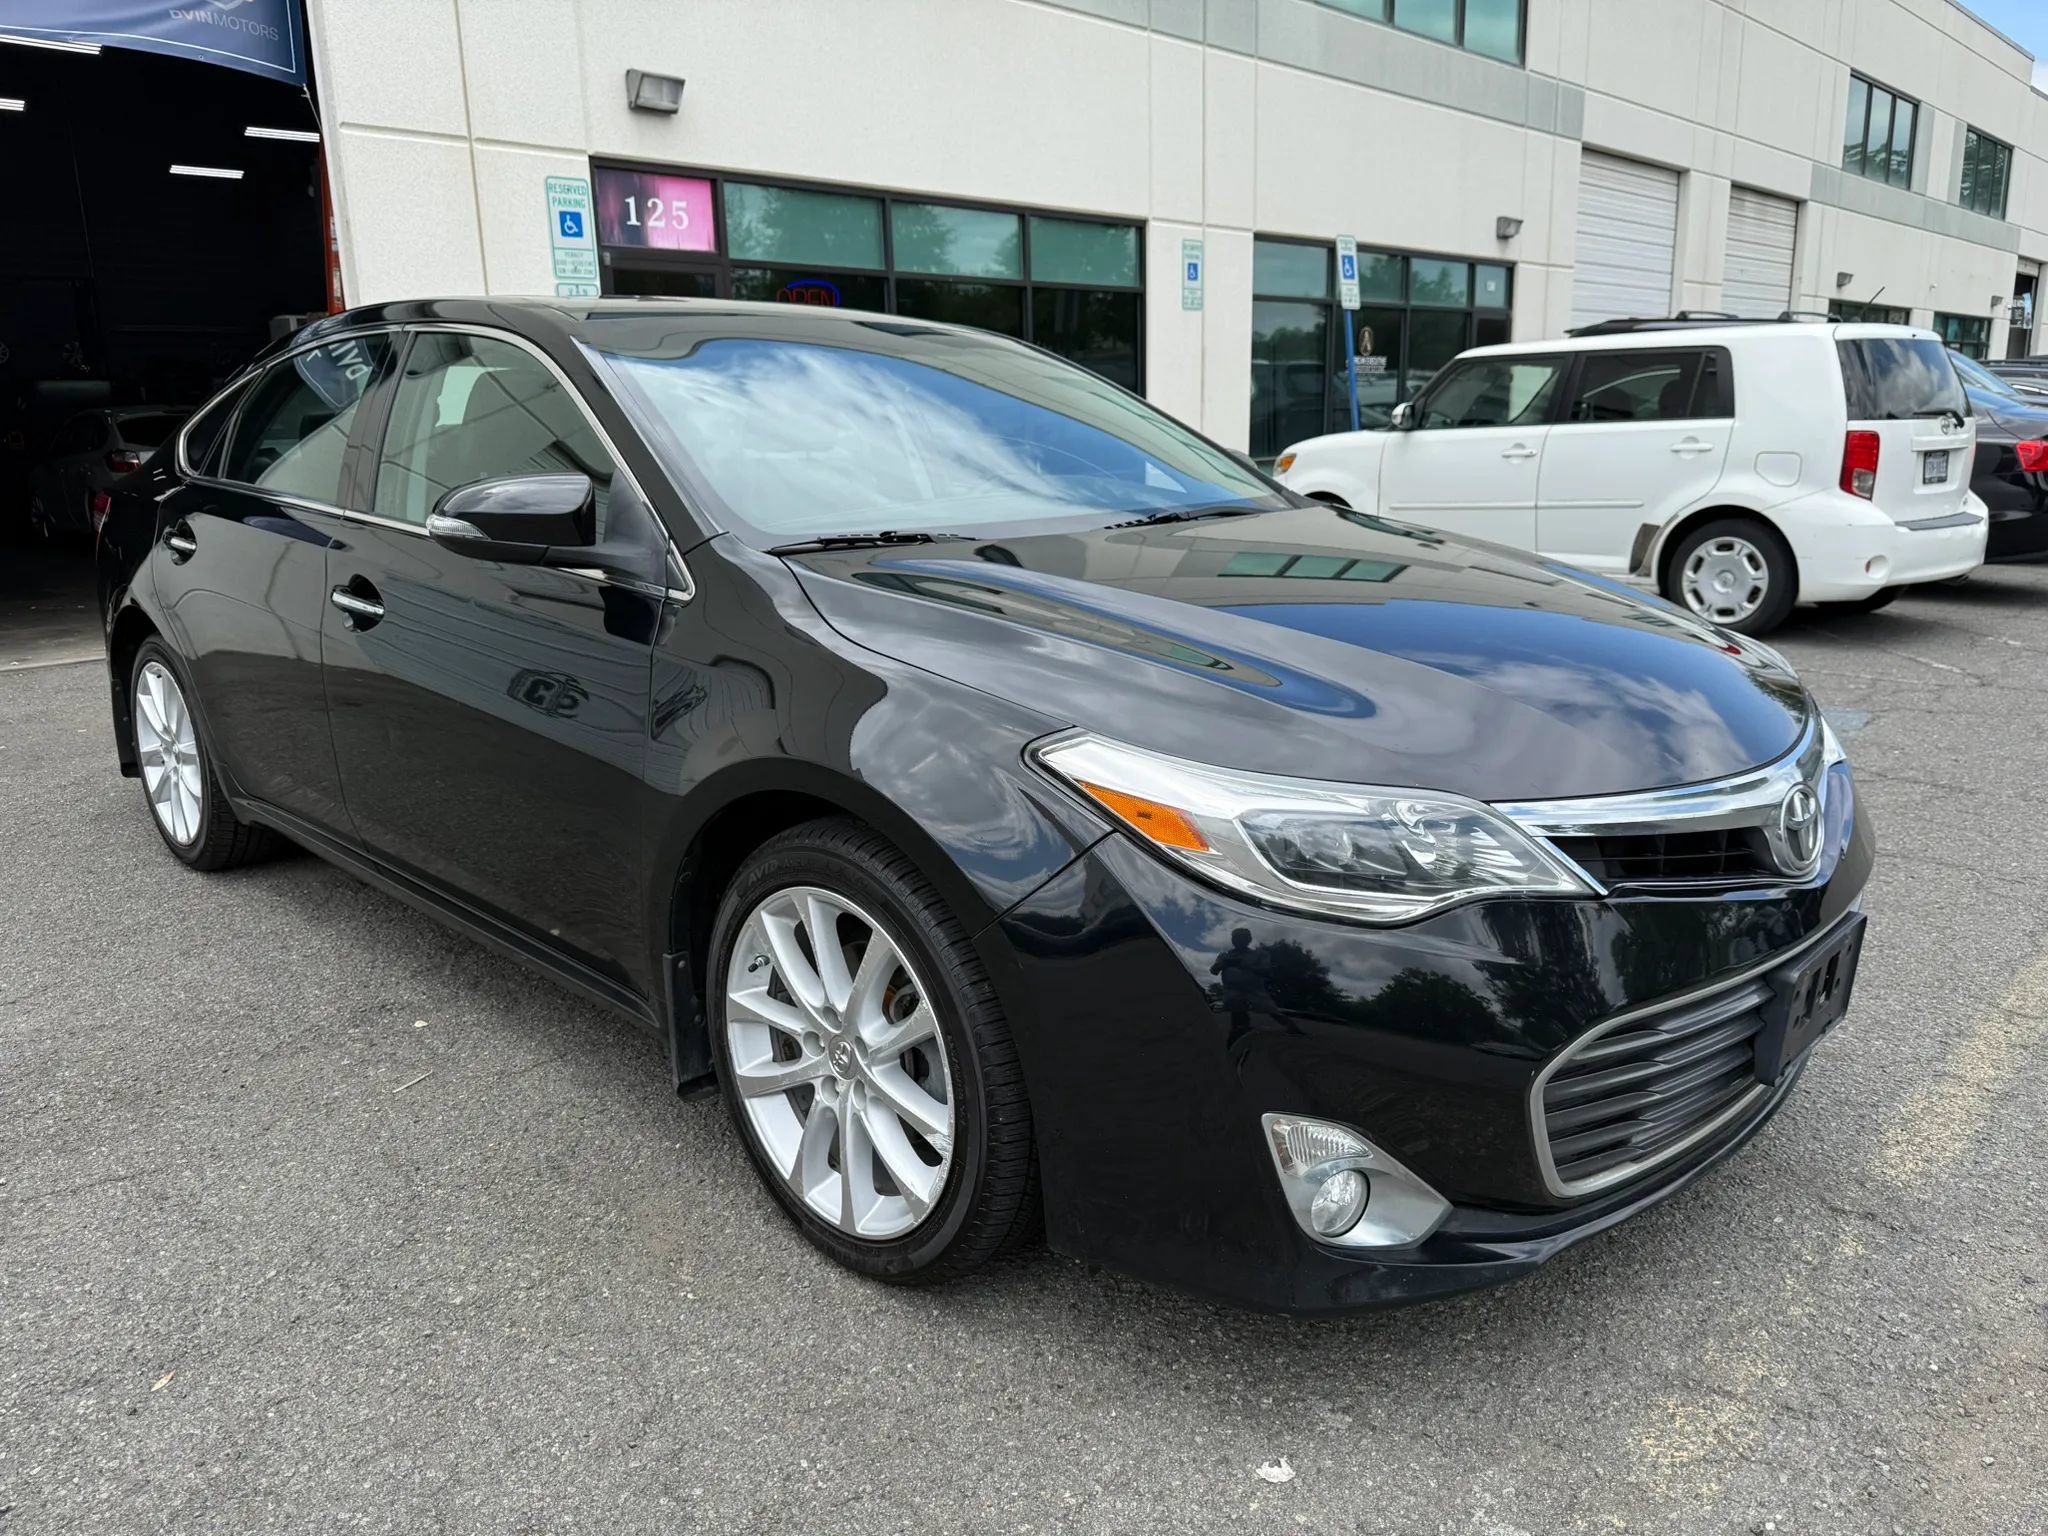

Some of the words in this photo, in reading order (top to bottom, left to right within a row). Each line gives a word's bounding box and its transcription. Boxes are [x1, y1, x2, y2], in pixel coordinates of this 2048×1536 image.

[548, 182, 588, 197] RESERVED
[551, 195, 586, 209] PARKING
[624, 195, 690, 231] 125
